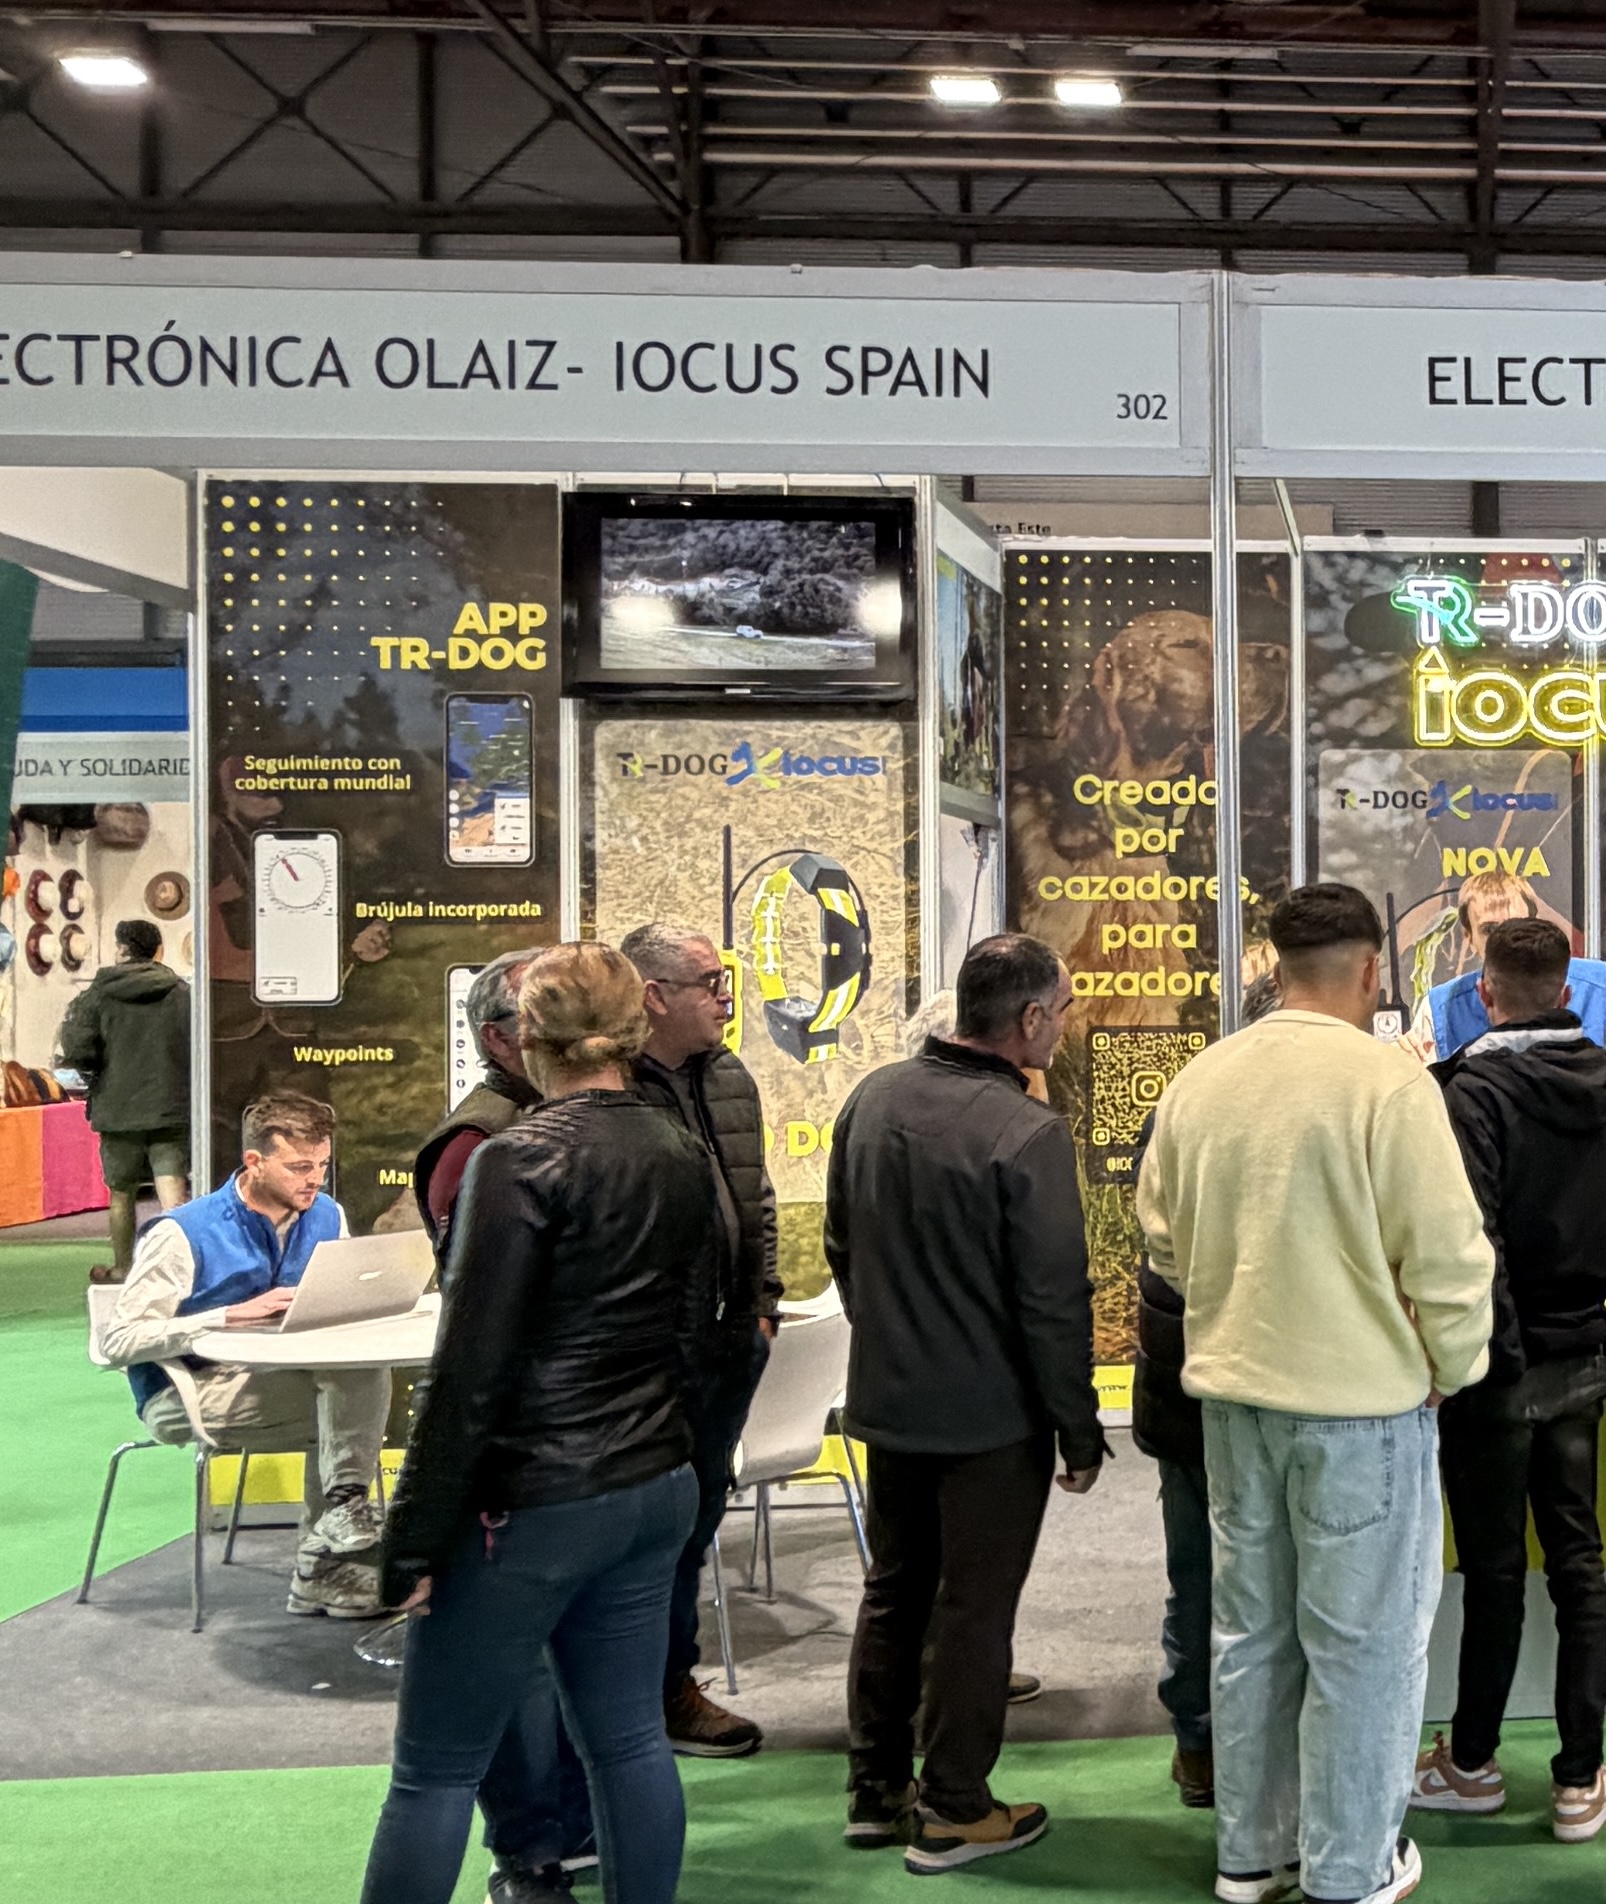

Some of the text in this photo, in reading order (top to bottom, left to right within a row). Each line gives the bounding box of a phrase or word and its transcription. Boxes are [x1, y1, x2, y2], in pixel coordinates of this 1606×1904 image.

[615, 340, 798, 395] IOCUS
[825, 344, 989, 398] SPAIN
[1116, 394, 1168, 420] 302
[452, 601, 548, 635] APP
[369, 636, 547, 671] TR-DOG
[58, 759, 72, 776] Y
[244, 755, 401, 775] Seguimiento con
[234, 774, 411, 791] cobertura mundial
[1115, 828, 1184, 860] por
[1442, 847, 1551, 878] NOVA
[355, 901, 542, 922] Brújula incorporada
[1102, 923, 1197, 955] para
[1070, 965, 1220, 997] azador
[294, 1044, 394, 1066] Waypoints
